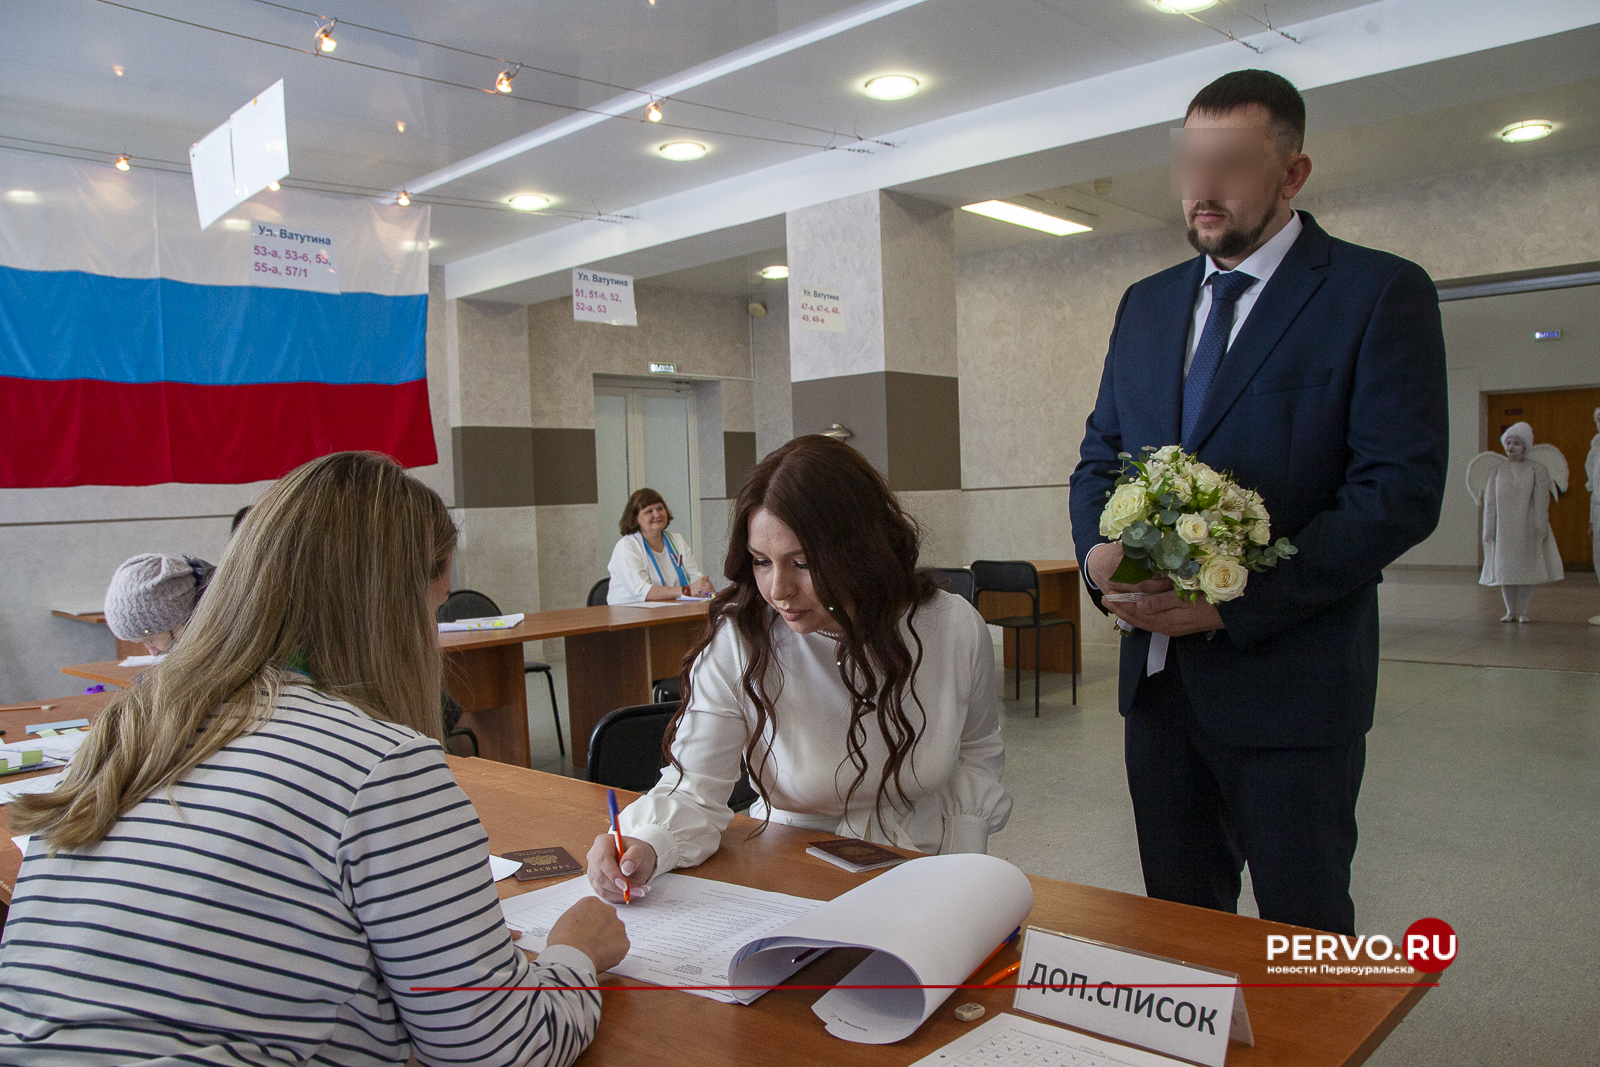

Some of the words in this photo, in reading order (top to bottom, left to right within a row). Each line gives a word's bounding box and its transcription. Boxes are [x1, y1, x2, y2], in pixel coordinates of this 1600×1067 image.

[258, 225, 277, 237] Ул.
[280, 228, 332, 245] Ватутина
[254, 245, 281, 260] 53-а,
[285, 249, 312, 264] 53-б,
[254, 261, 281, 276] 55-а,
[285, 266, 308, 277] 57/1
[577, 271, 591, 282] Ул.
[592, 273, 628, 287] Ватутина
[575, 288, 587, 298] 51,
[589, 289, 608, 302] 51-б,
[610, 292, 622, 303] 52,
[813, 290, 840, 301] Ватутина
[575, 302, 595, 313] 52-а,
[597, 304, 607, 313] 53
[1535, 330, 1558, 339] ЫХОД
[526, 863, 570, 874] ПАСПОРТ
[1026, 962, 1218, 1036] ДОП.СПИСОК
